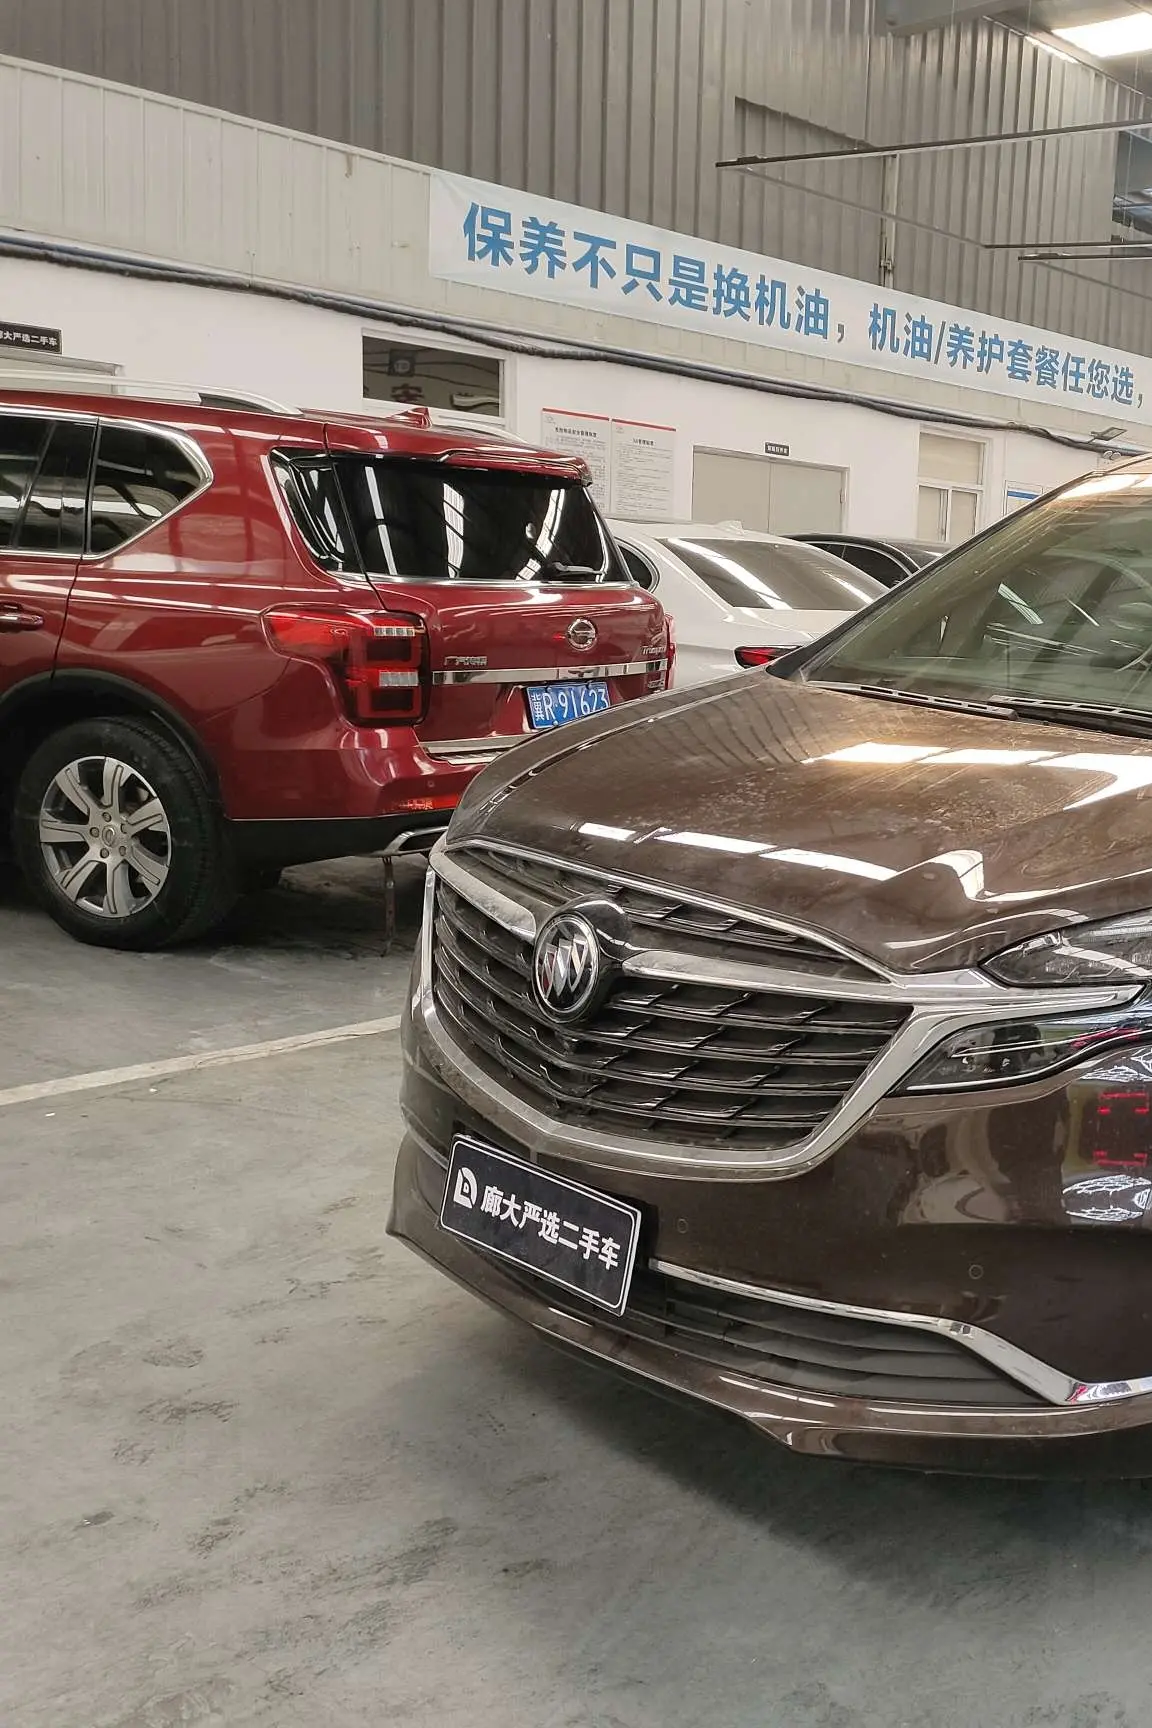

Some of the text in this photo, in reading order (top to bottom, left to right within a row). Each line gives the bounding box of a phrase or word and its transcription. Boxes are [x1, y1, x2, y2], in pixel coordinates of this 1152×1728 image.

[480, 1185, 621, 1270] 廊大严选二手车
